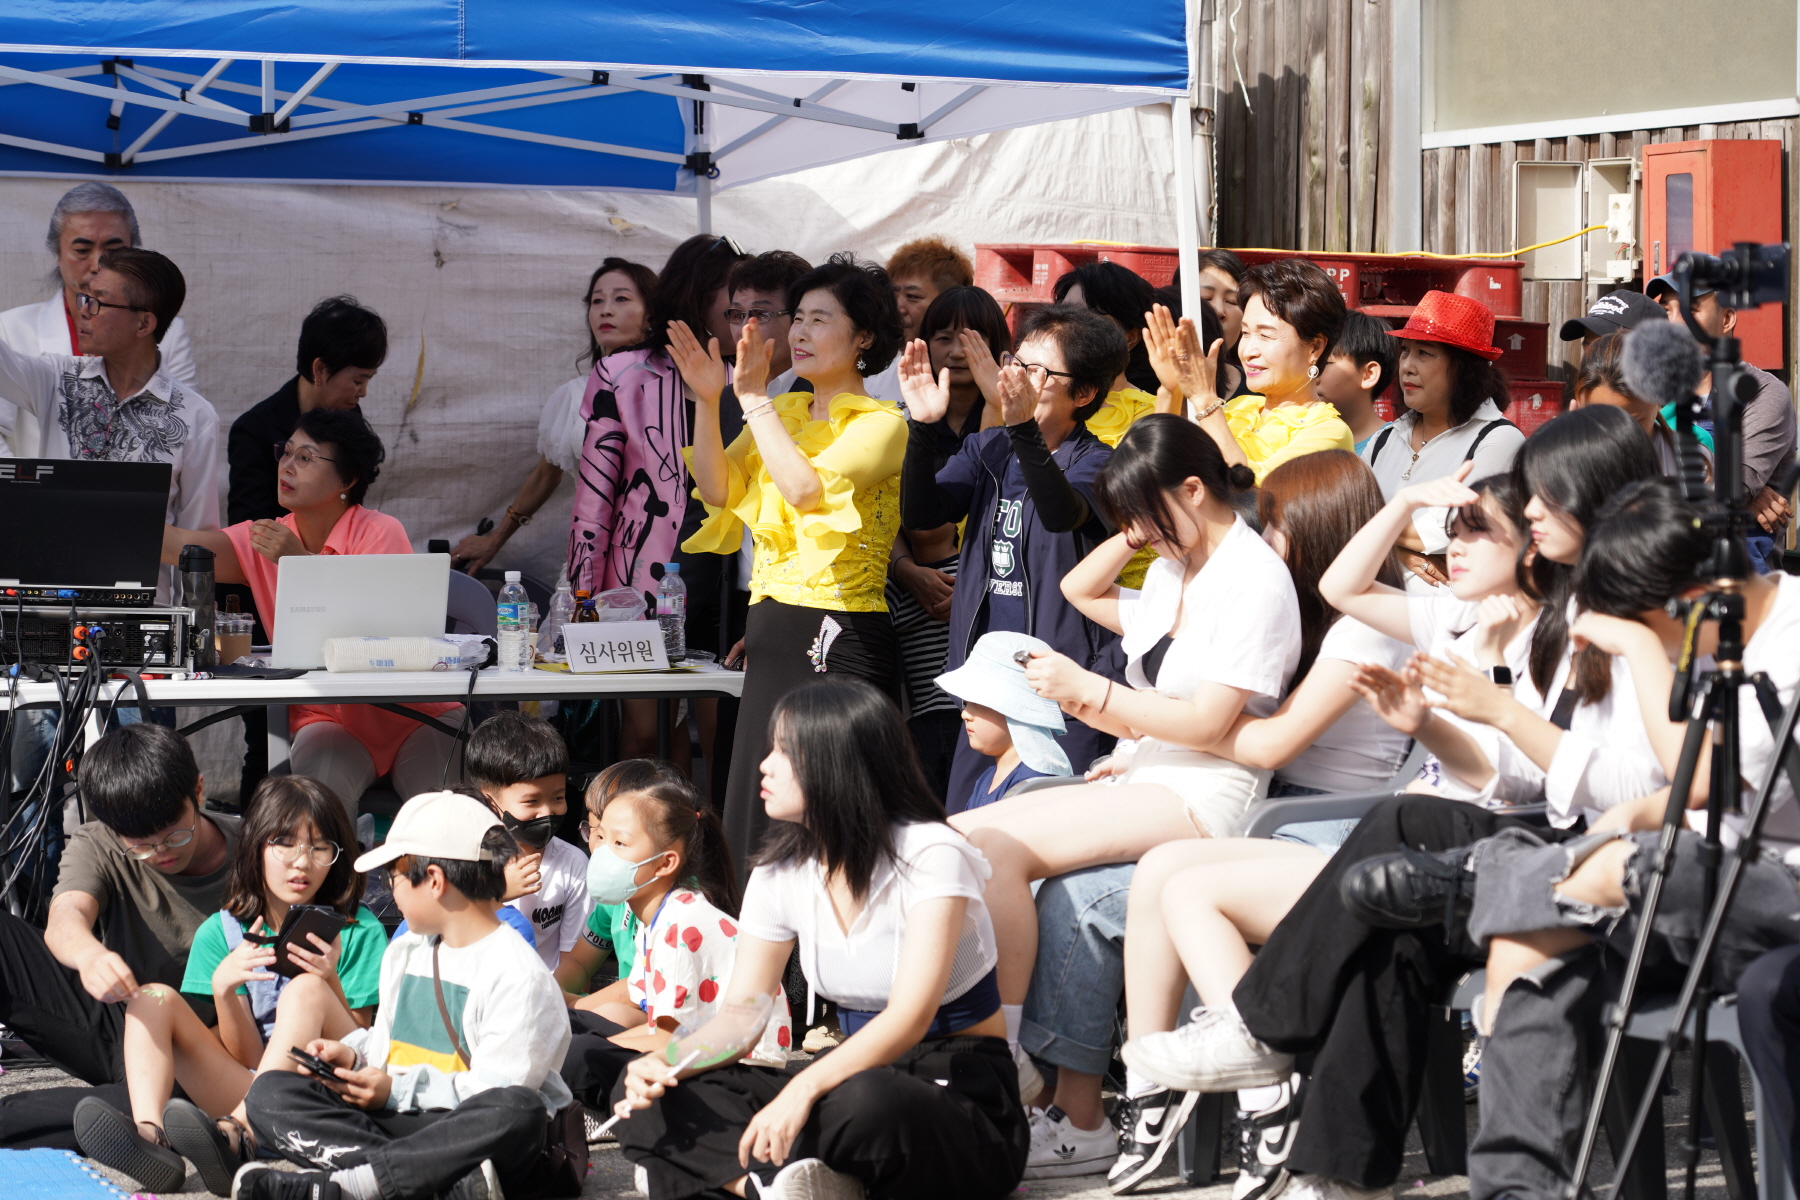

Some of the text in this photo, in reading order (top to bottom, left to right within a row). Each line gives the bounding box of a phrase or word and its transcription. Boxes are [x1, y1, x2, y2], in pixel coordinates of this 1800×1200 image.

[289, 605, 326, 613] SAMSUNG
[579, 639, 655, 664] 심사위원
[586, 930, 613, 948] POLO
